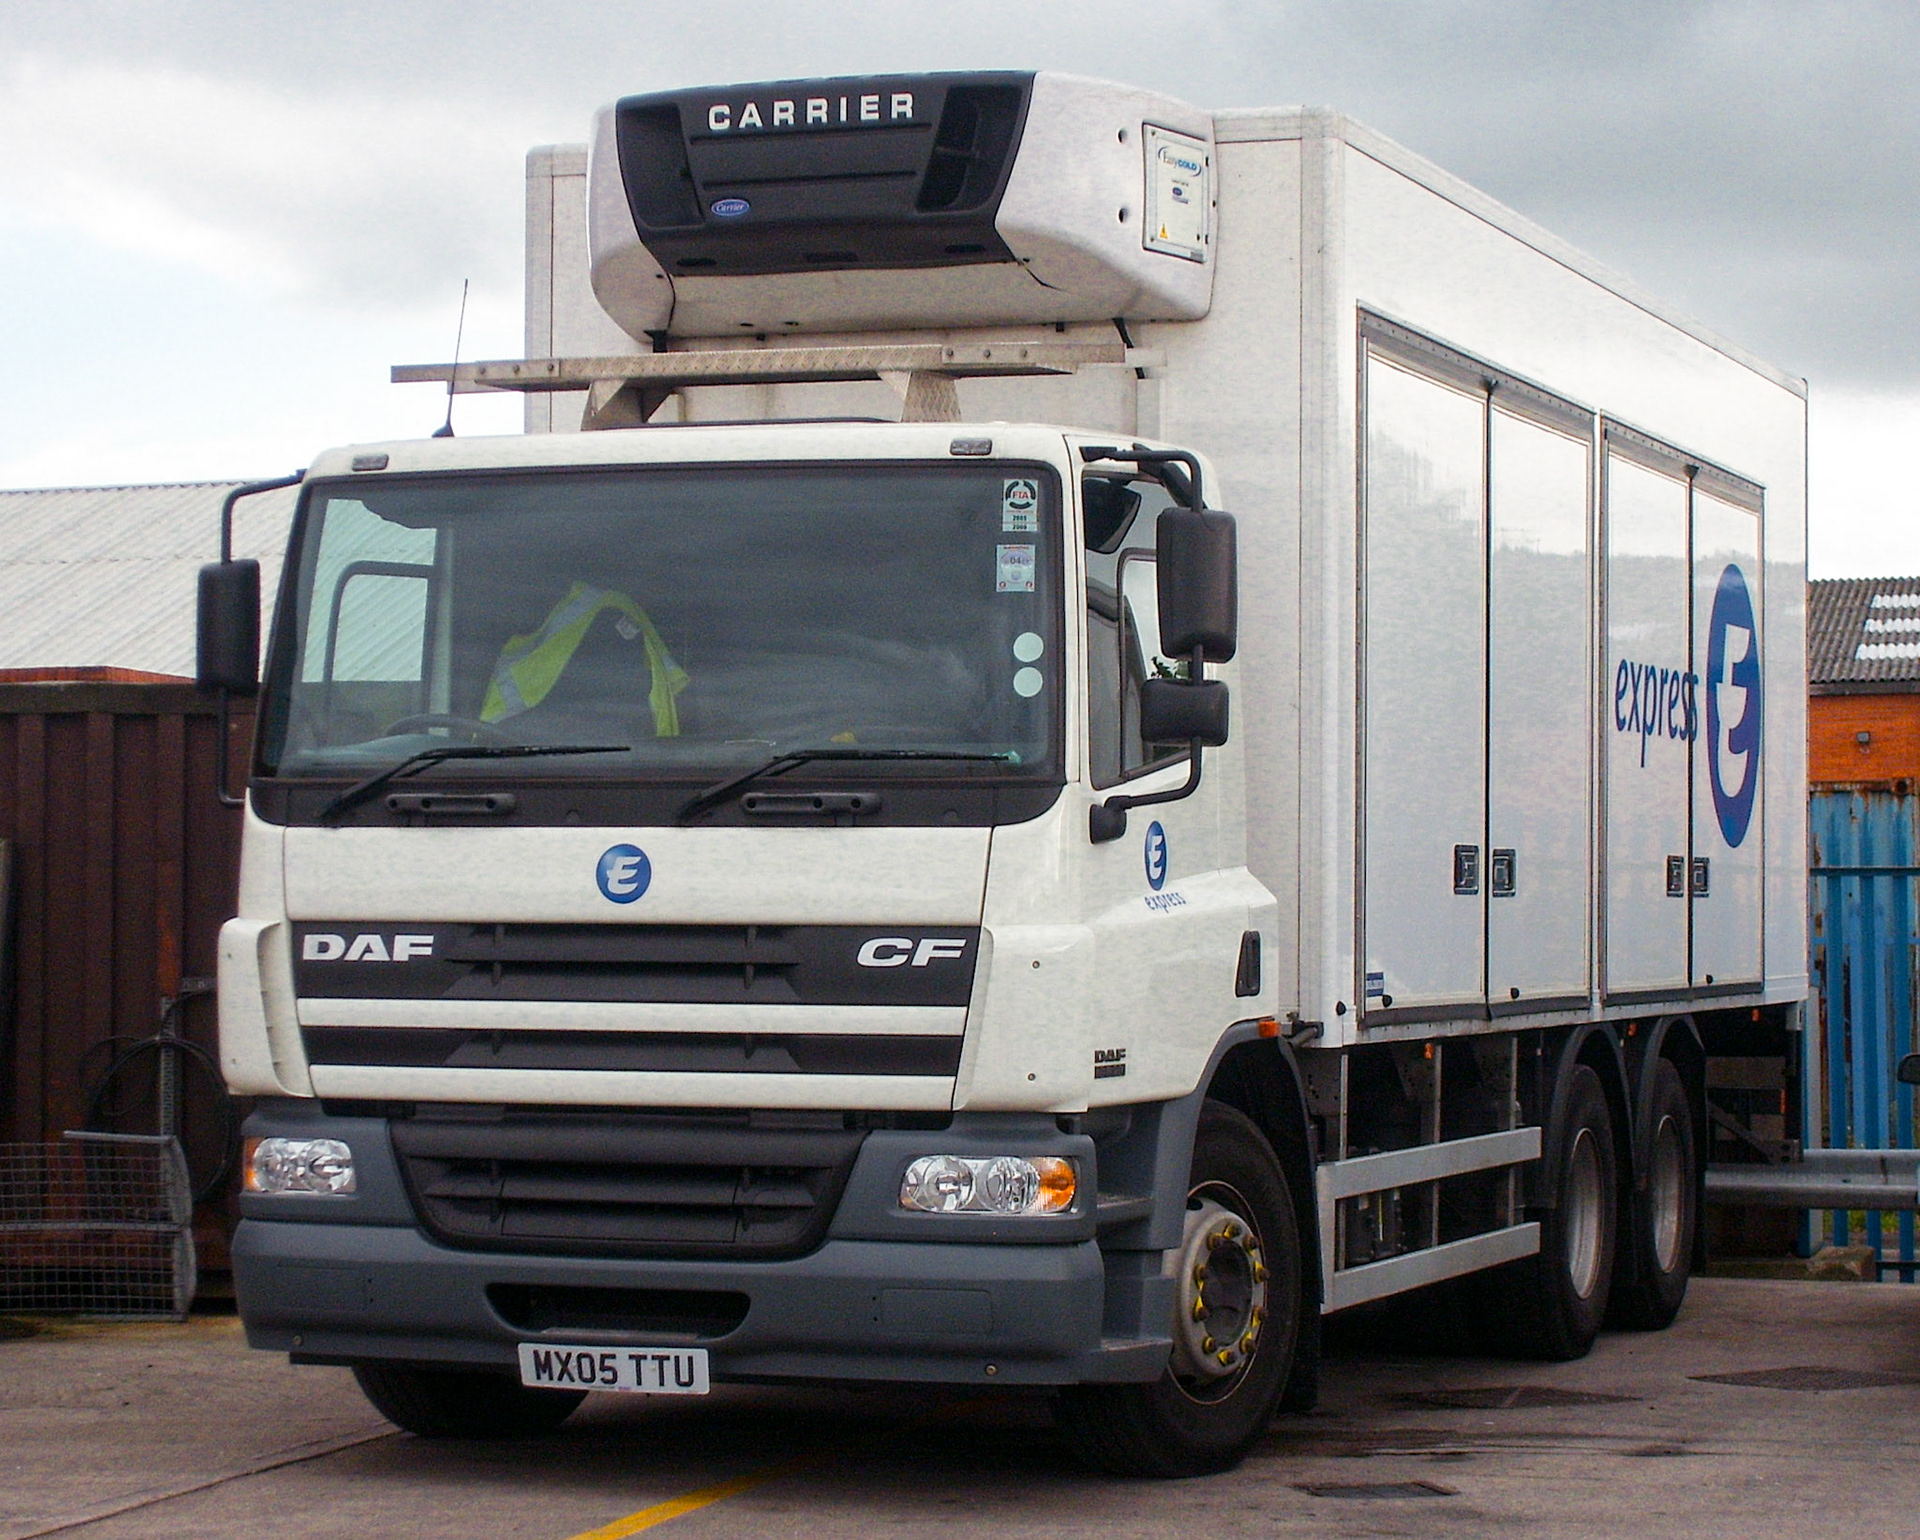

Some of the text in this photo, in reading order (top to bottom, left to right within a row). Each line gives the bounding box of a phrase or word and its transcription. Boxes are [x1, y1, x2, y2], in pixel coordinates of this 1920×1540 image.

[707, 92, 915, 132] CARRIER
[715, 202, 745, 212] Carrier
[1012, 491, 1029, 499] FTA
[1614, 658, 1699, 768] express
[1143, 890, 1188, 914] express
[302, 933, 434, 962] DAF
[856, 938, 967, 968] CF
[1094, 1048, 1126, 1063] DAF
[532, 1349, 694, 1387] MX05 TTU
